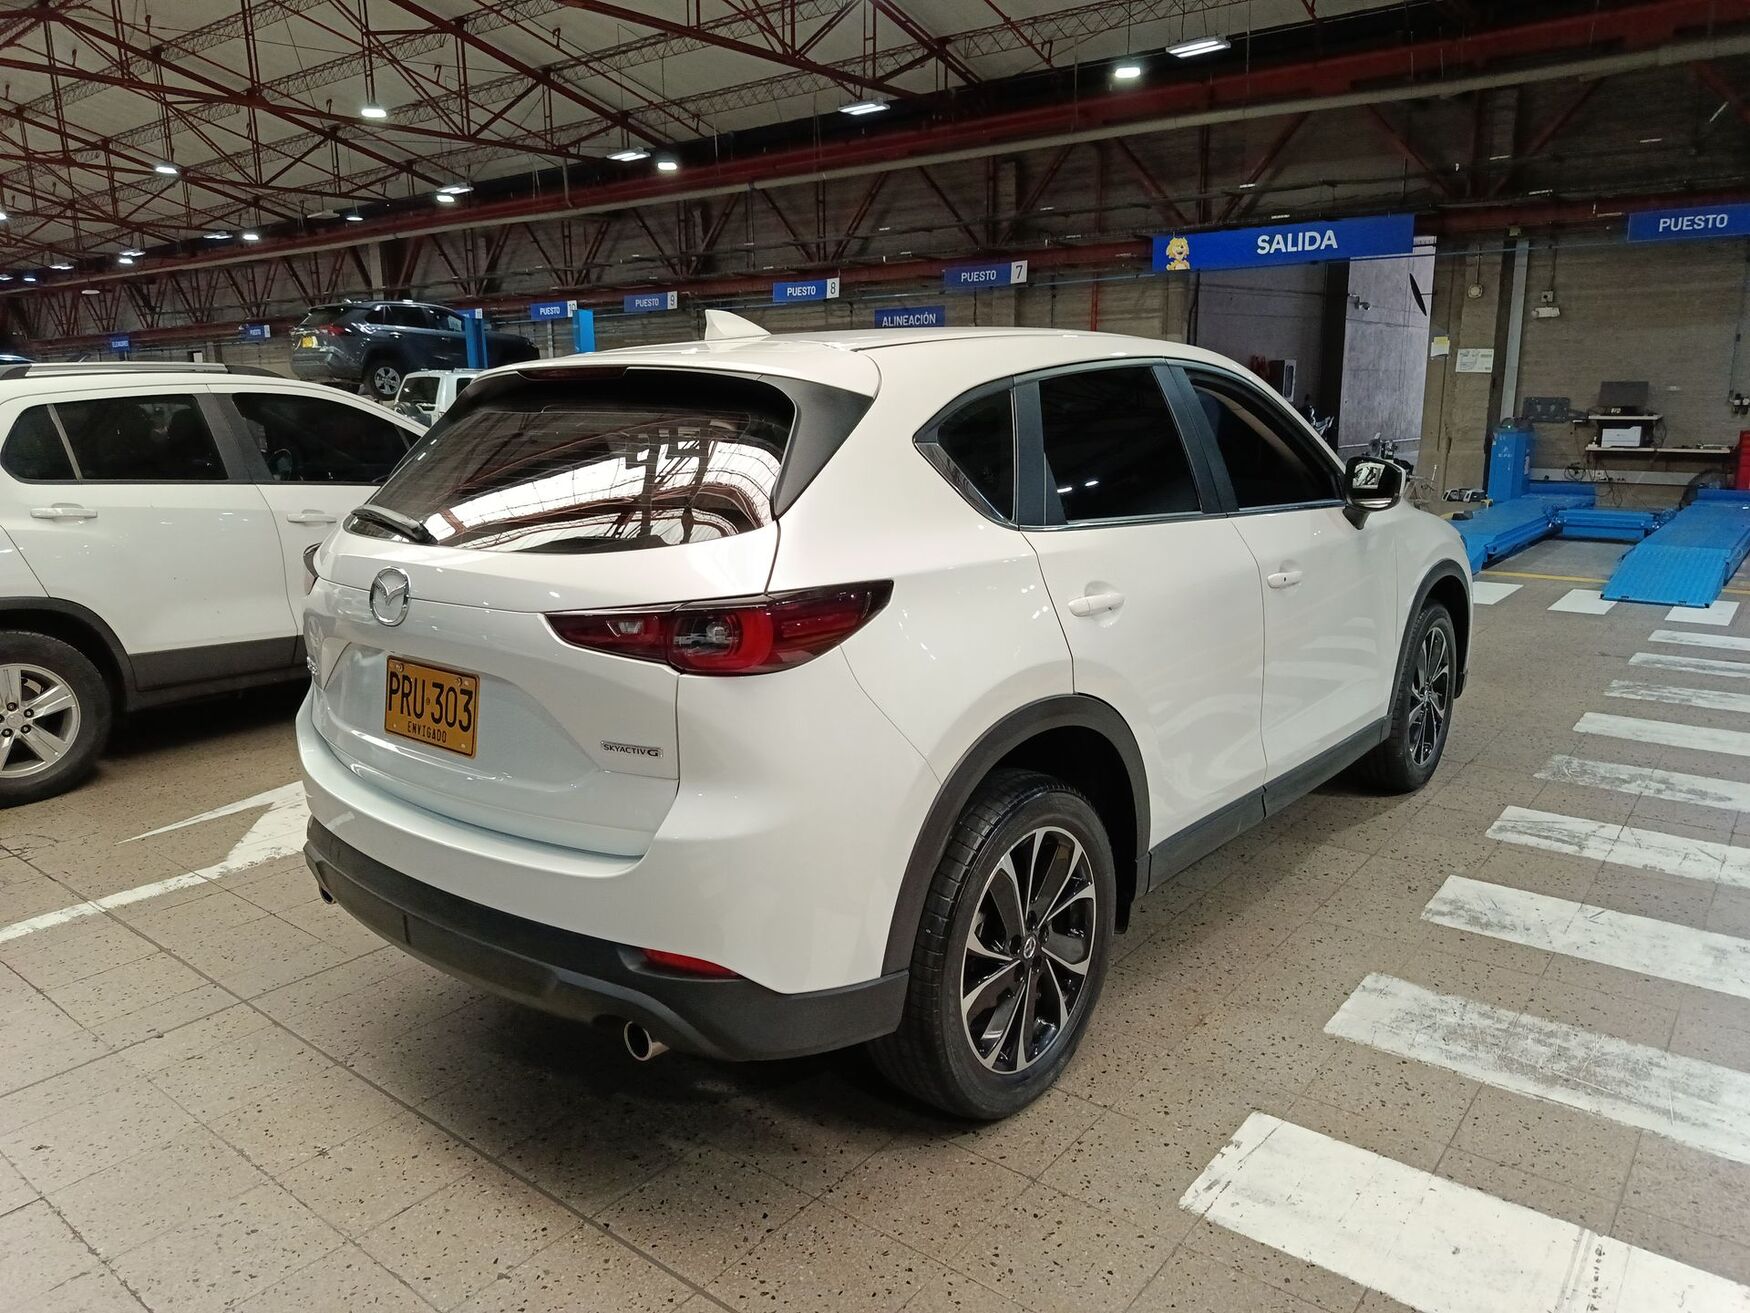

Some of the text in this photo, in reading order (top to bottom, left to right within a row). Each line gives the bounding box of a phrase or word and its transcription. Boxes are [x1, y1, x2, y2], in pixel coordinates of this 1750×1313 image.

[1658, 213, 1728, 232] PUESTO
[1256, 229, 1338, 255] SALIDA
[961, 264, 1024, 283] PUESTO 7
[787, 282, 836, 297] PUESTO 8
[635, 295, 675, 308] PUESTO 9
[539, 306, 560, 316] PUESTO
[881, 311, 937, 327] ALINEACIÓN
[407, 721, 447, 743] ENVIGADO
